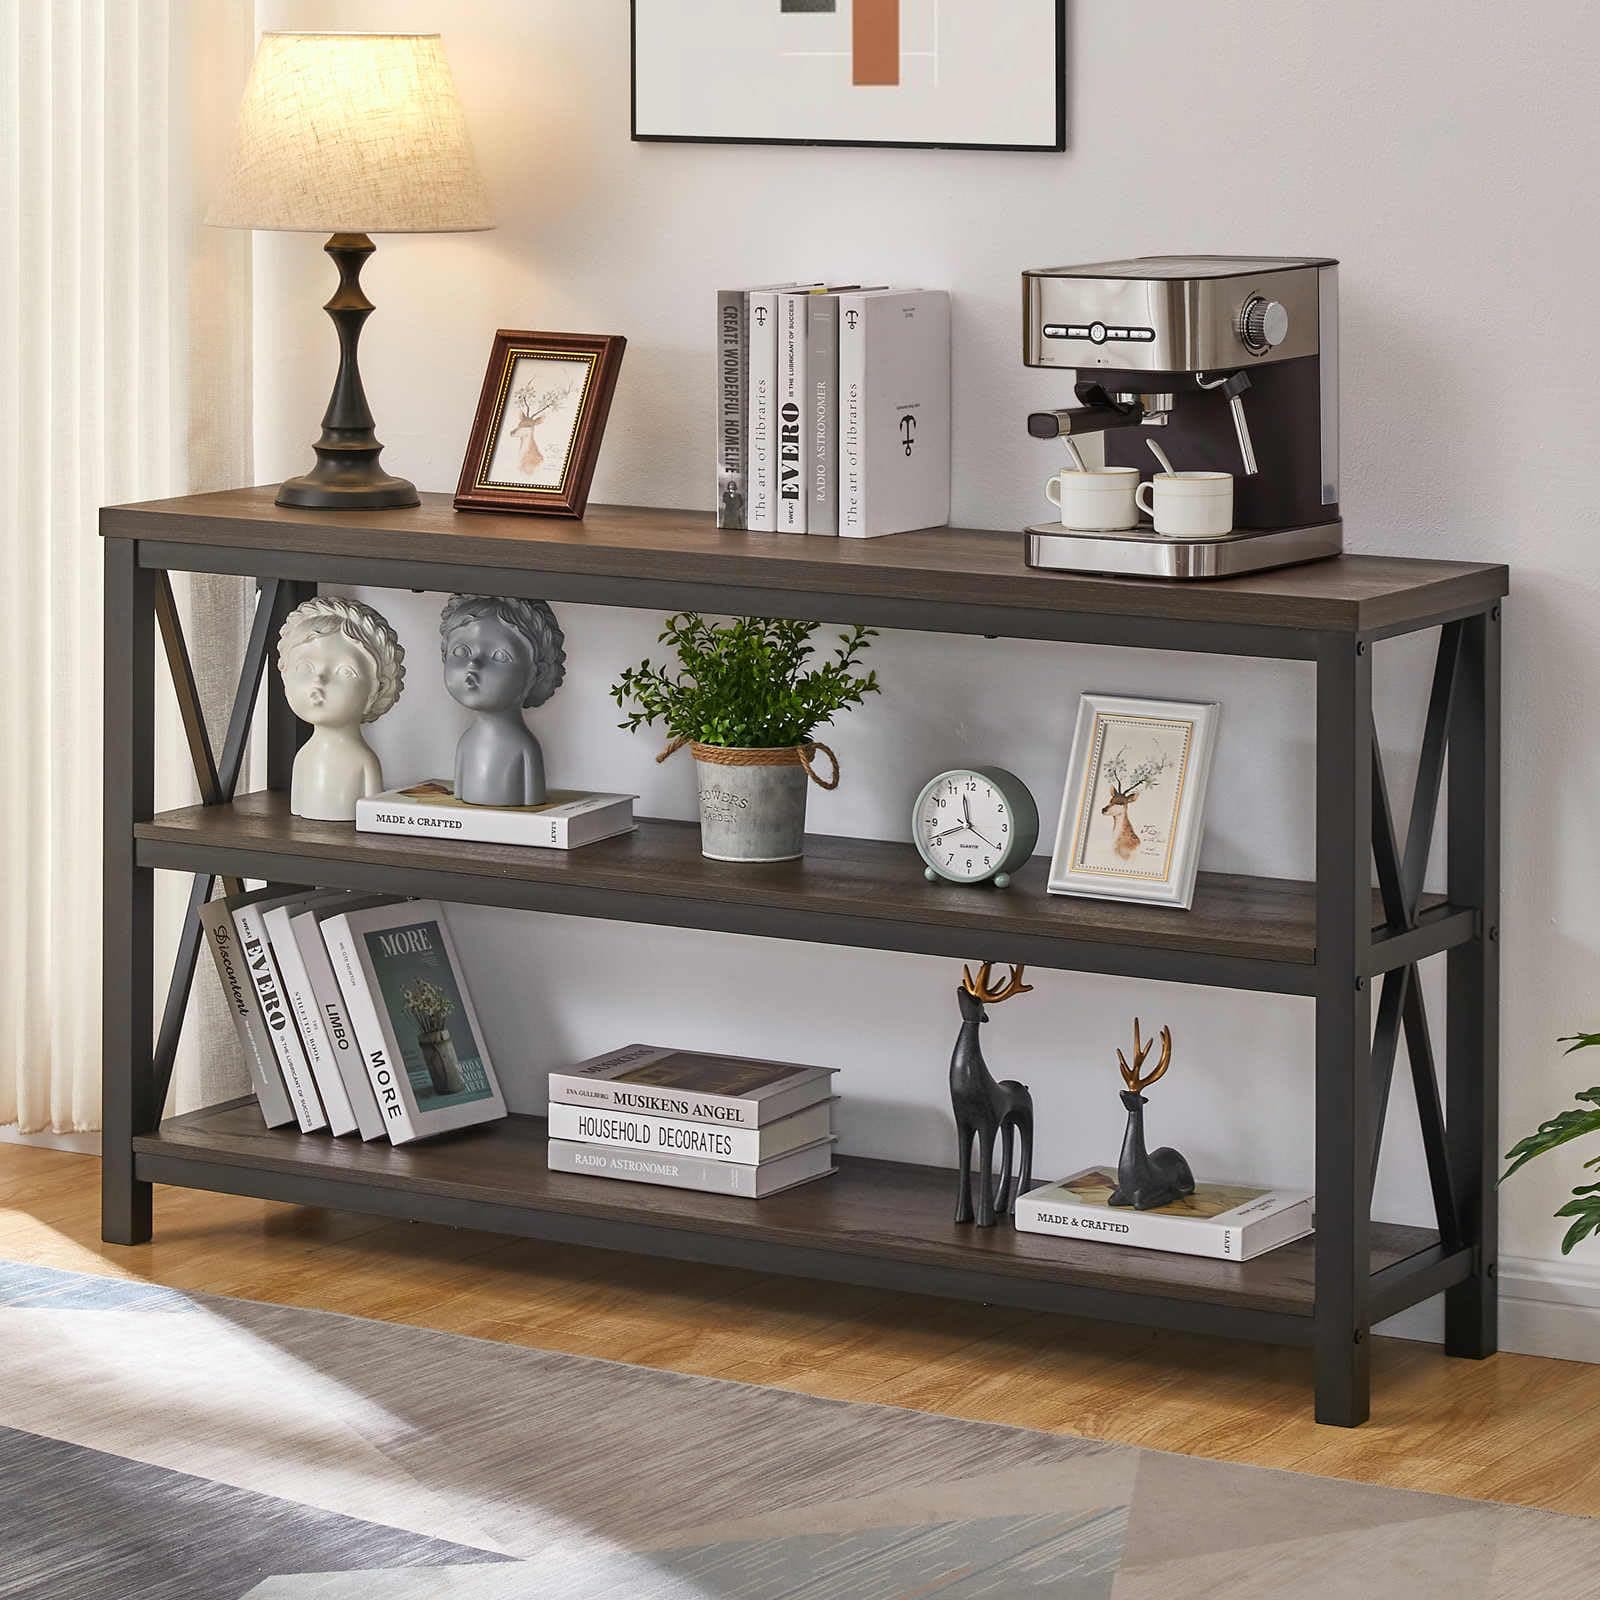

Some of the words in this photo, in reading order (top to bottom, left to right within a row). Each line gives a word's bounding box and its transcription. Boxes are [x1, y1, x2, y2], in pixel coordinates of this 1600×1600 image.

[722, 305, 739, 345] CREATE
[788, 330, 795, 339] OF
[723, 348, 740, 416] WONDERFUL
[788, 389, 795, 397] IS
[755, 379, 767, 441] libraries
[815, 381, 826, 458] ASTRONOMER
[846, 383, 857, 445] libraries
[724, 419, 741, 474] HOMELIFE
[755, 444, 767, 461] of
[781, 402, 800, 501] EVERO
[846, 448, 857, 466] of
[757, 467, 767, 487] art
[815, 465, 826, 504] RADIO
[849, 472, 857, 493] art
[755, 493, 767, 520] The
[846, 497, 857, 527] The
[948, 786, 958, 795] 11
[965, 782, 977, 792] 12
[986, 789, 991, 798] 1
[936, 799, 947, 808] 10
[997, 803, 1004, 813] 2
[375, 813, 406, 825] MADE
[407, 816, 416, 825] &
[416, 817, 463, 829] CRAFTED
[931, 818, 938, 826] 9
[1001, 823, 1008, 832] 3
[936, 837, 943, 846] 8
[947, 853, 955, 862] 7
[966, 859, 973, 868] 6
[983, 856, 990, 865] 5
[241, 917, 252, 939] SWEAT
[378, 928, 432, 958] MORE
[212, 924, 251, 1016] Discontent
[244, 938, 287, 1031] EVERO
[325, 1003, 349, 1051] LIMBO
[285, 1055, 301, 1089] LUBRICANT
[370, 1050, 402, 1120] MORE
[299, 1097, 313, 1127] SUCCESS
[613, 1092, 689, 1114] MUSIKENS
[692, 1103, 745, 1123] ANGEL
[578, 1115, 651, 1144] HOUSEHOLD
[658, 1126, 732, 1156] DECORATES
[575, 1153, 607, 1168] RADIO
[610, 1159, 680, 1177] ASTRONOMER
[1037, 1213, 1069, 1225] MADE
[1070, 1217, 1080, 1226] &
[1080, 1219, 1130, 1233] CRAFTED
